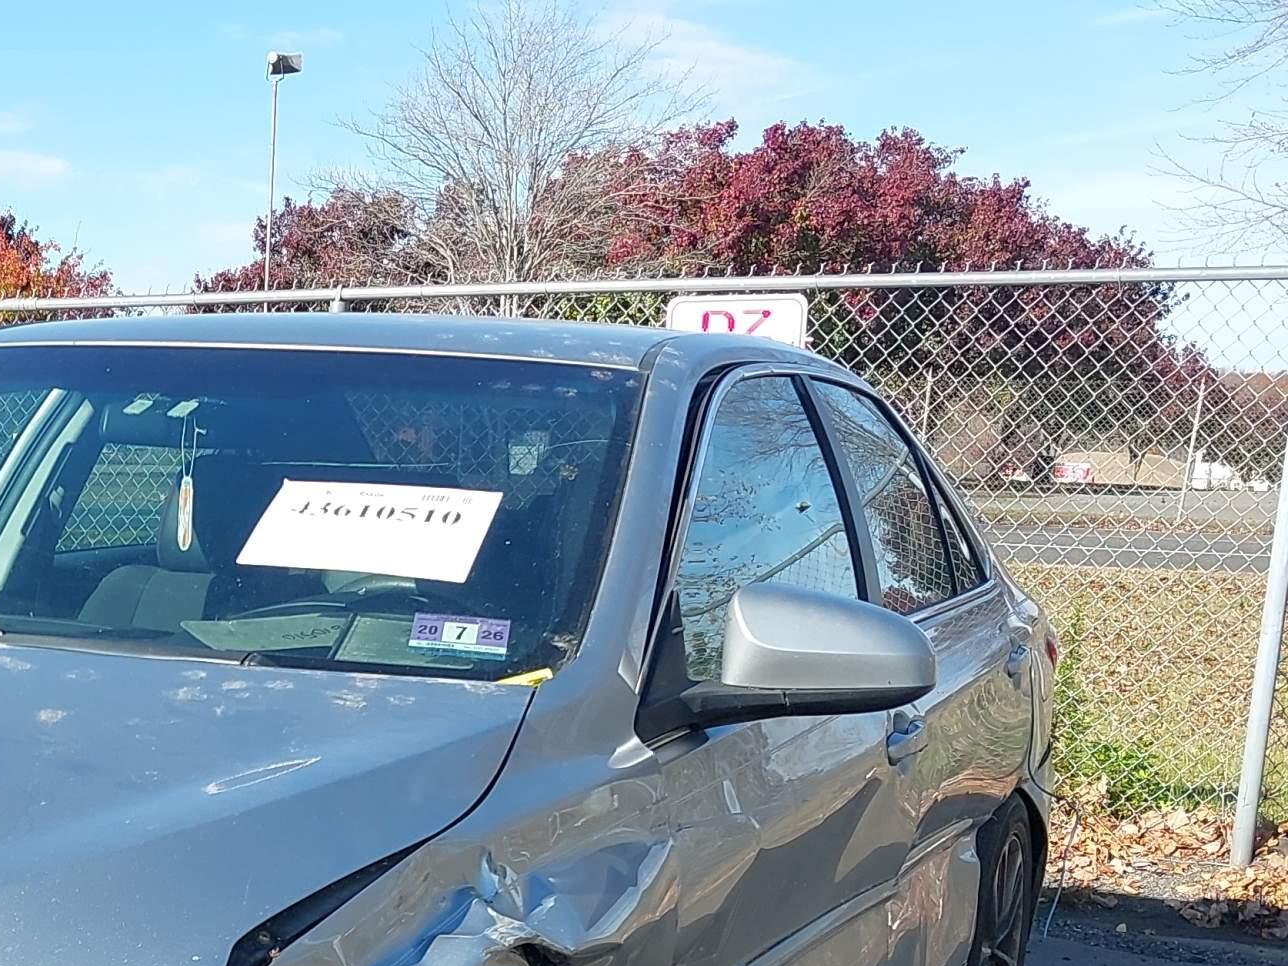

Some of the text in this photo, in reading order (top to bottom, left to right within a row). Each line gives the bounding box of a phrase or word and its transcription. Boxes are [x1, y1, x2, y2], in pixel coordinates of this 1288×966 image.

[417, 624, 505, 642] 20 7 26
